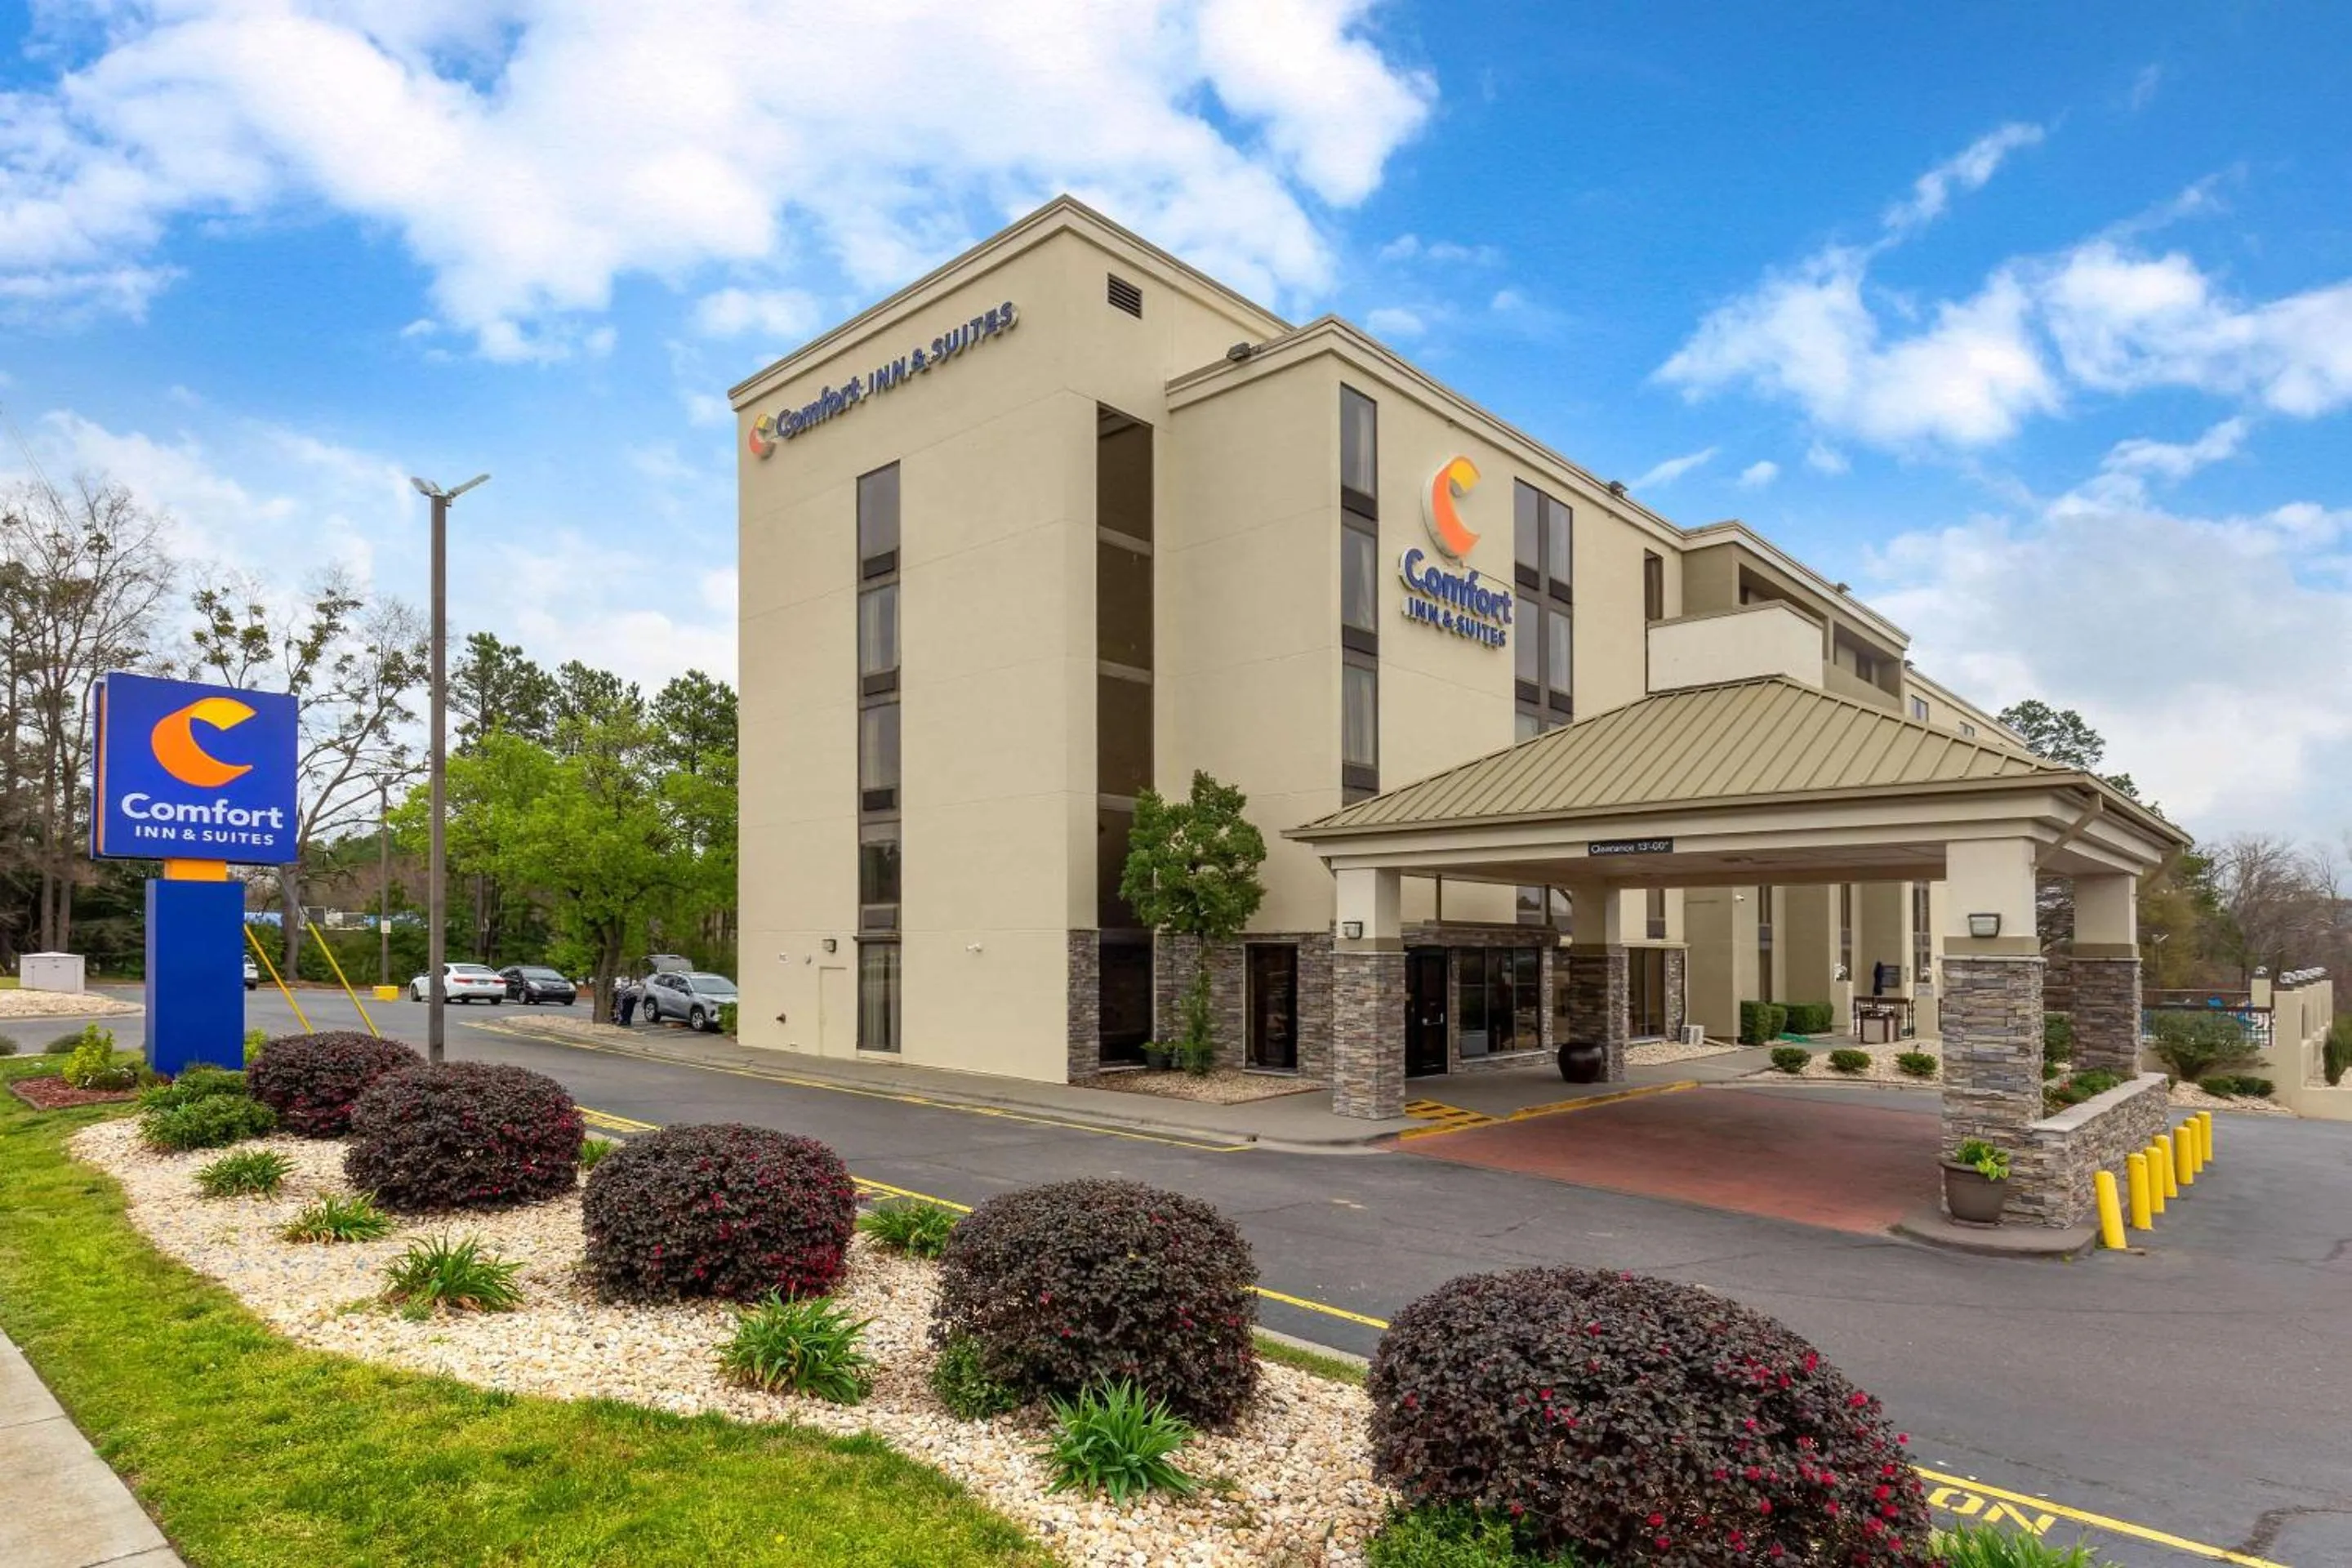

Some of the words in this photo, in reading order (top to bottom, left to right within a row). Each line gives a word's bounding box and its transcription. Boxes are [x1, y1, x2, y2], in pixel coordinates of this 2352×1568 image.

[776, 375, 864, 439] Comfort
[867, 354, 906, 395] INN
[911, 348, 926, 371] &
[930, 300, 1014, 363] SUITES
[1403, 547, 1512, 626] Comfort
[1408, 596, 1439, 624] INN
[1442, 609, 1454, 629] &
[1455, 614, 1507, 648] SUITES
[121, 792, 283, 829] Comfort
[135, 825, 176, 840] INN
[181, 827, 197, 841] &
[203, 830, 274, 846] SUITES
